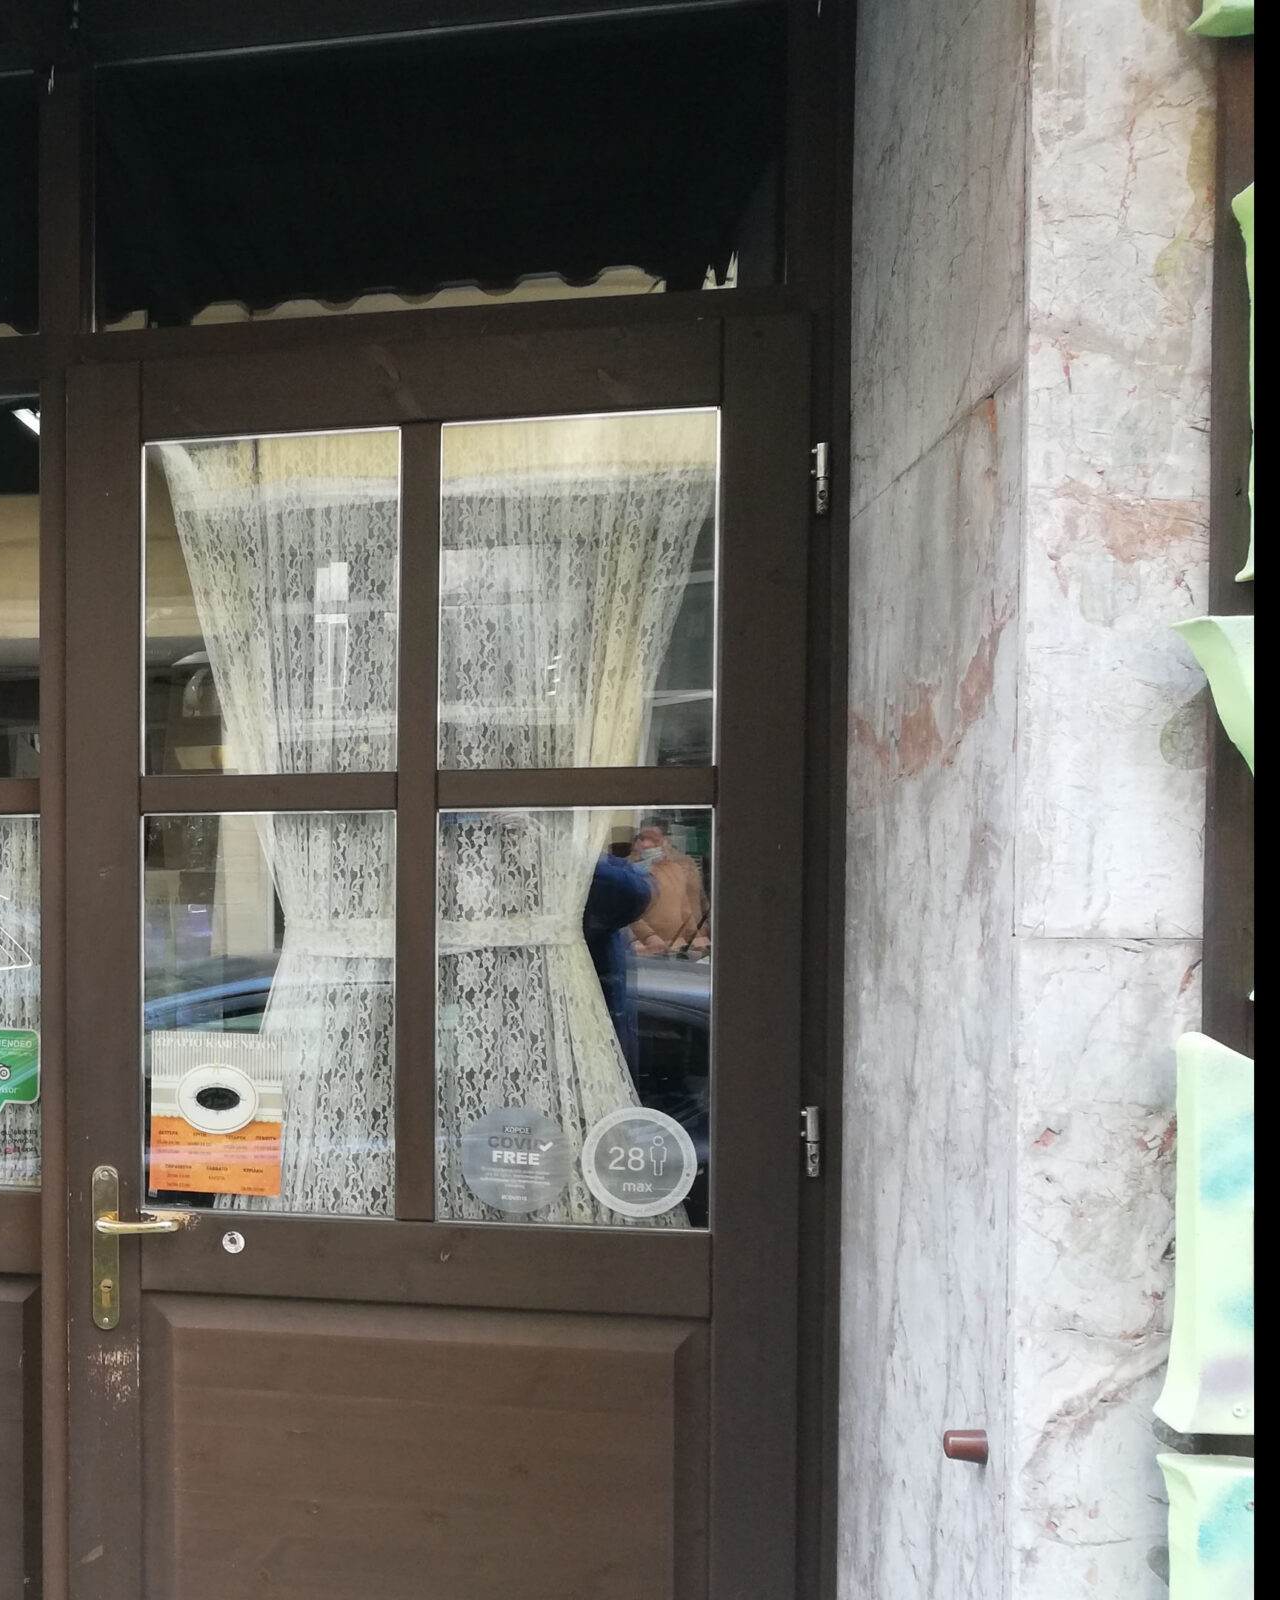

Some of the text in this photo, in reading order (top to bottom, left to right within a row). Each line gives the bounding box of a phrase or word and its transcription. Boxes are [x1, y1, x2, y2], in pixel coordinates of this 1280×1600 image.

[505, 1126, 530, 1135] ΧΩΡΟΣ
[492, 1150, 541, 1166] FREE
[608, 1146, 645, 1172] 28
[622, 1182, 653, 1193] max
